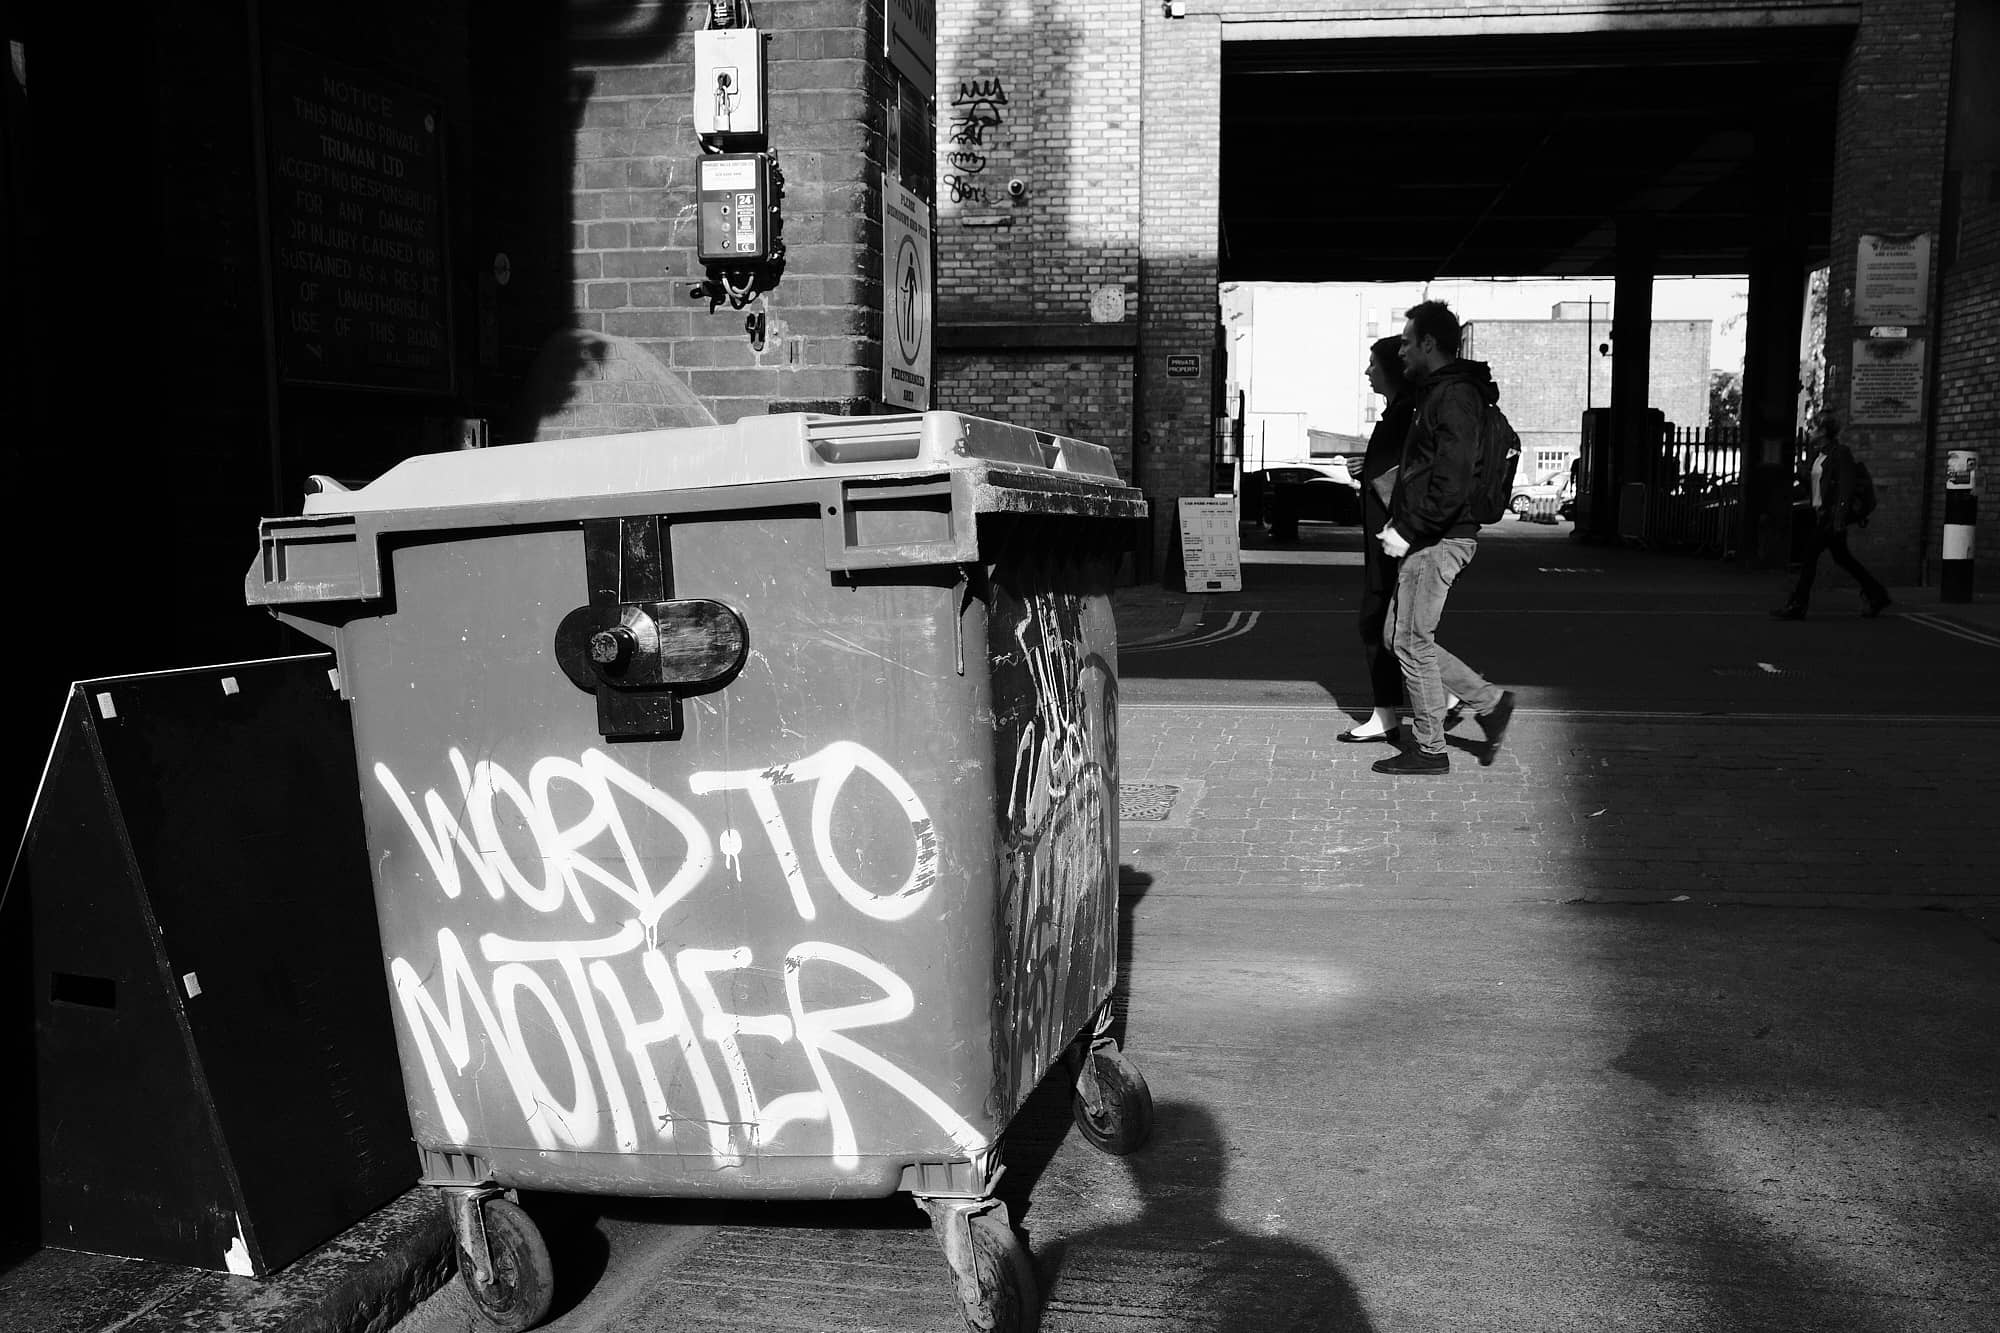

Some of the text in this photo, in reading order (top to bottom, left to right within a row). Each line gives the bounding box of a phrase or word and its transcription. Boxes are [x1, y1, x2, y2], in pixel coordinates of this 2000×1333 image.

[320, 73, 393, 118] NOTICE
[292, 96, 328, 126] THIS
[330, 108, 364, 137] ROAD
[365, 121, 377, 139] IS
[278, 151, 329, 185] ACCEPT
[331, 167, 349, 192] NO
[320, 135, 377, 170] TRUMAN
[296, 190, 425, 240] FOR ANY DAMAGE
[310, 224, 357, 252] INJURY
[361, 235, 414, 263] CAUSED
[417, 248, 436, 266] OR
[281, 248, 353, 279] SUSTAINED
[359, 264, 375, 284] AS
[378, 266, 389, 286] A
[299, 281, 321, 304] OF
[290, 308, 321, 335] USE
[335, 317, 353, 337] OF
[368, 320, 400, 344] THIS
[373, 741, 938, 924] WORD TO
[391, 919, 989, 1169] MOTHER
